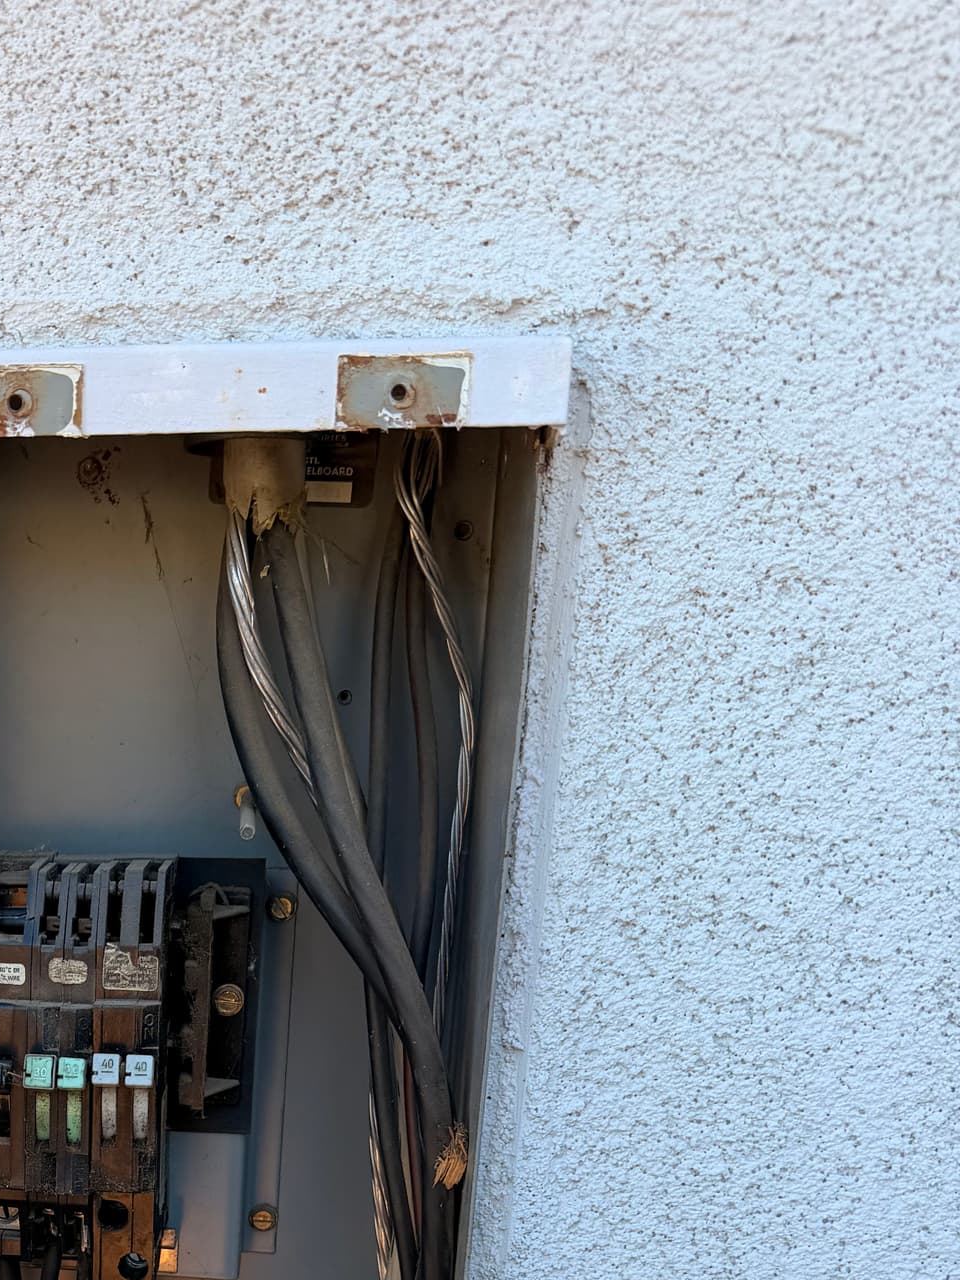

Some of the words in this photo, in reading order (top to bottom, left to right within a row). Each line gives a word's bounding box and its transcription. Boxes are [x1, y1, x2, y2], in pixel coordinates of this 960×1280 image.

[306, 466, 353, 476] ELBOARD
[101, 1058, 114, 1069] 40
[135, 1061, 148, 1072] 40
